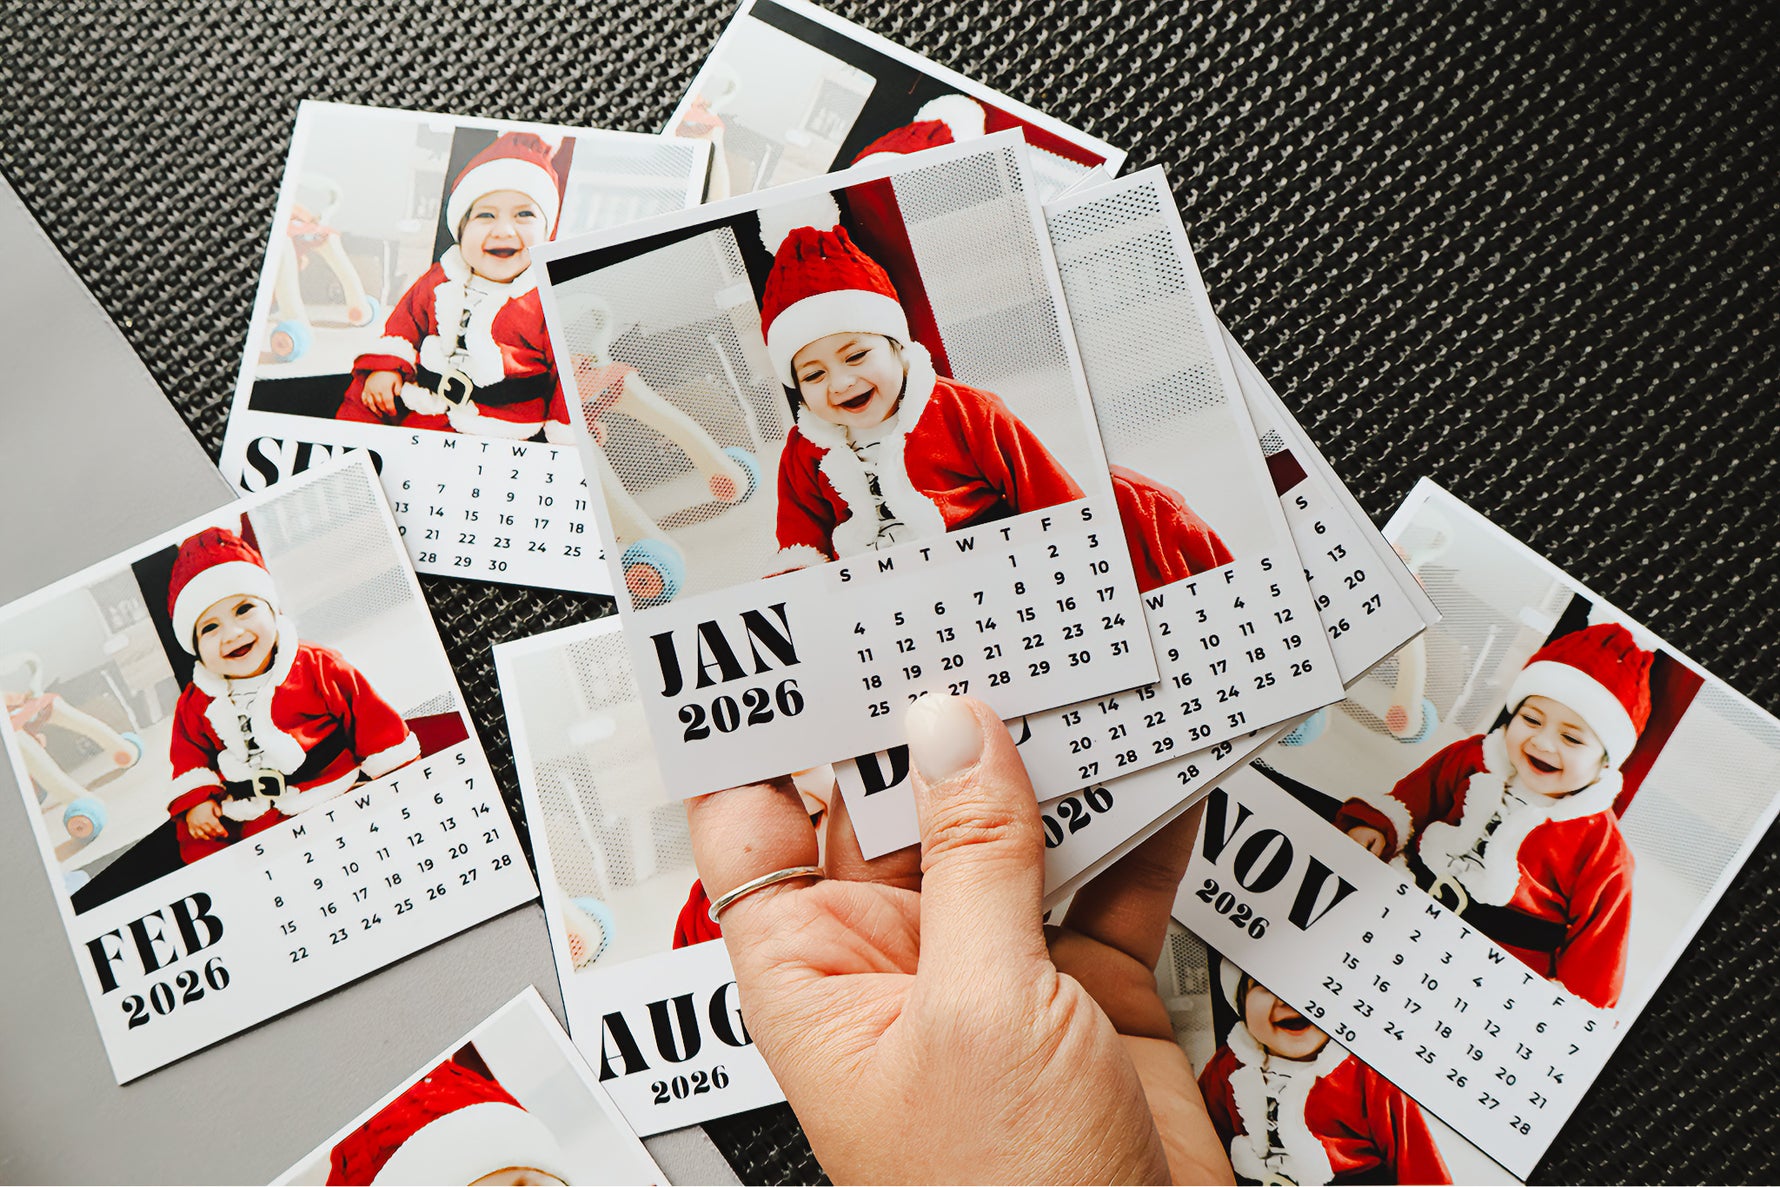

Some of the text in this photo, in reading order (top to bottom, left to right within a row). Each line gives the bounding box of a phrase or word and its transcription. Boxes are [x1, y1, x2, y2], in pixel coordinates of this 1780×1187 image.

[412, 436, 558, 460] S M T W T
[396, 502, 584, 533] 13 14 15 16 17 18
[539, 496, 586, 510] 10 11
[1296, 496, 1308, 510] S
[1314, 521, 1326, 534] 6
[419, 552, 507, 571] 28 29 30
[425, 529, 581, 557] 21 22 23 24 25
[840, 508, 1092, 582] S M T W T F S
[1054, 560, 1109, 585] 9 10
[1327, 544, 1346, 562] 13
[1146, 558, 1272, 610] W T F S
[1344, 570, 1365, 590] 20
[650, 602, 801, 697] JAN
[858, 586, 1114, 663] 11 12 13 14 15 16 17
[1200, 609, 1293, 650] 10 11 12
[1328, 594, 1381, 639] 26 27
[863, 613, 1125, 690] 18 19 20 21 22 23 24
[868, 640, 1129, 717] 25 27 28 29 30 31
[1062, 635, 1301, 727] 13 14 15 16 17 18 19
[678, 679, 804, 743] 2026
[1070, 660, 1312, 754] 20 21 22 23 24 25 26
[1079, 712, 1246, 779] 27 28 29 30 31
[1177, 740, 1232, 785] 28 29
[255, 753, 465, 856] S M T W T F S
[274, 803, 489, 907] 8 10 11 12 13 14
[281, 829, 499, 935] 15 16 17 18 19 20 21
[1202, 787, 1358, 931] NOV
[290, 855, 511, 963] 22 23 24 25 26 27 28
[1195, 878, 1270, 940] 2026
[85, 892, 224, 995] FEB
[1397, 884, 1596, 1032] S M T W T F S
[1441, 952, 1452, 964] 3
[122, 956, 230, 1030] 2026
[1305, 1000, 1356, 1042] 29 30
[599, 981, 753, 1082] AUG
[1323, 976, 1531, 1135] 22 23 24 25 26 27 28
[1343, 952, 1547, 1109] 15 16 17 18 19 20 21
[1421, 973, 1563, 1084] 10 11 12 13 14
[651, 1065, 729, 1105] 2026
